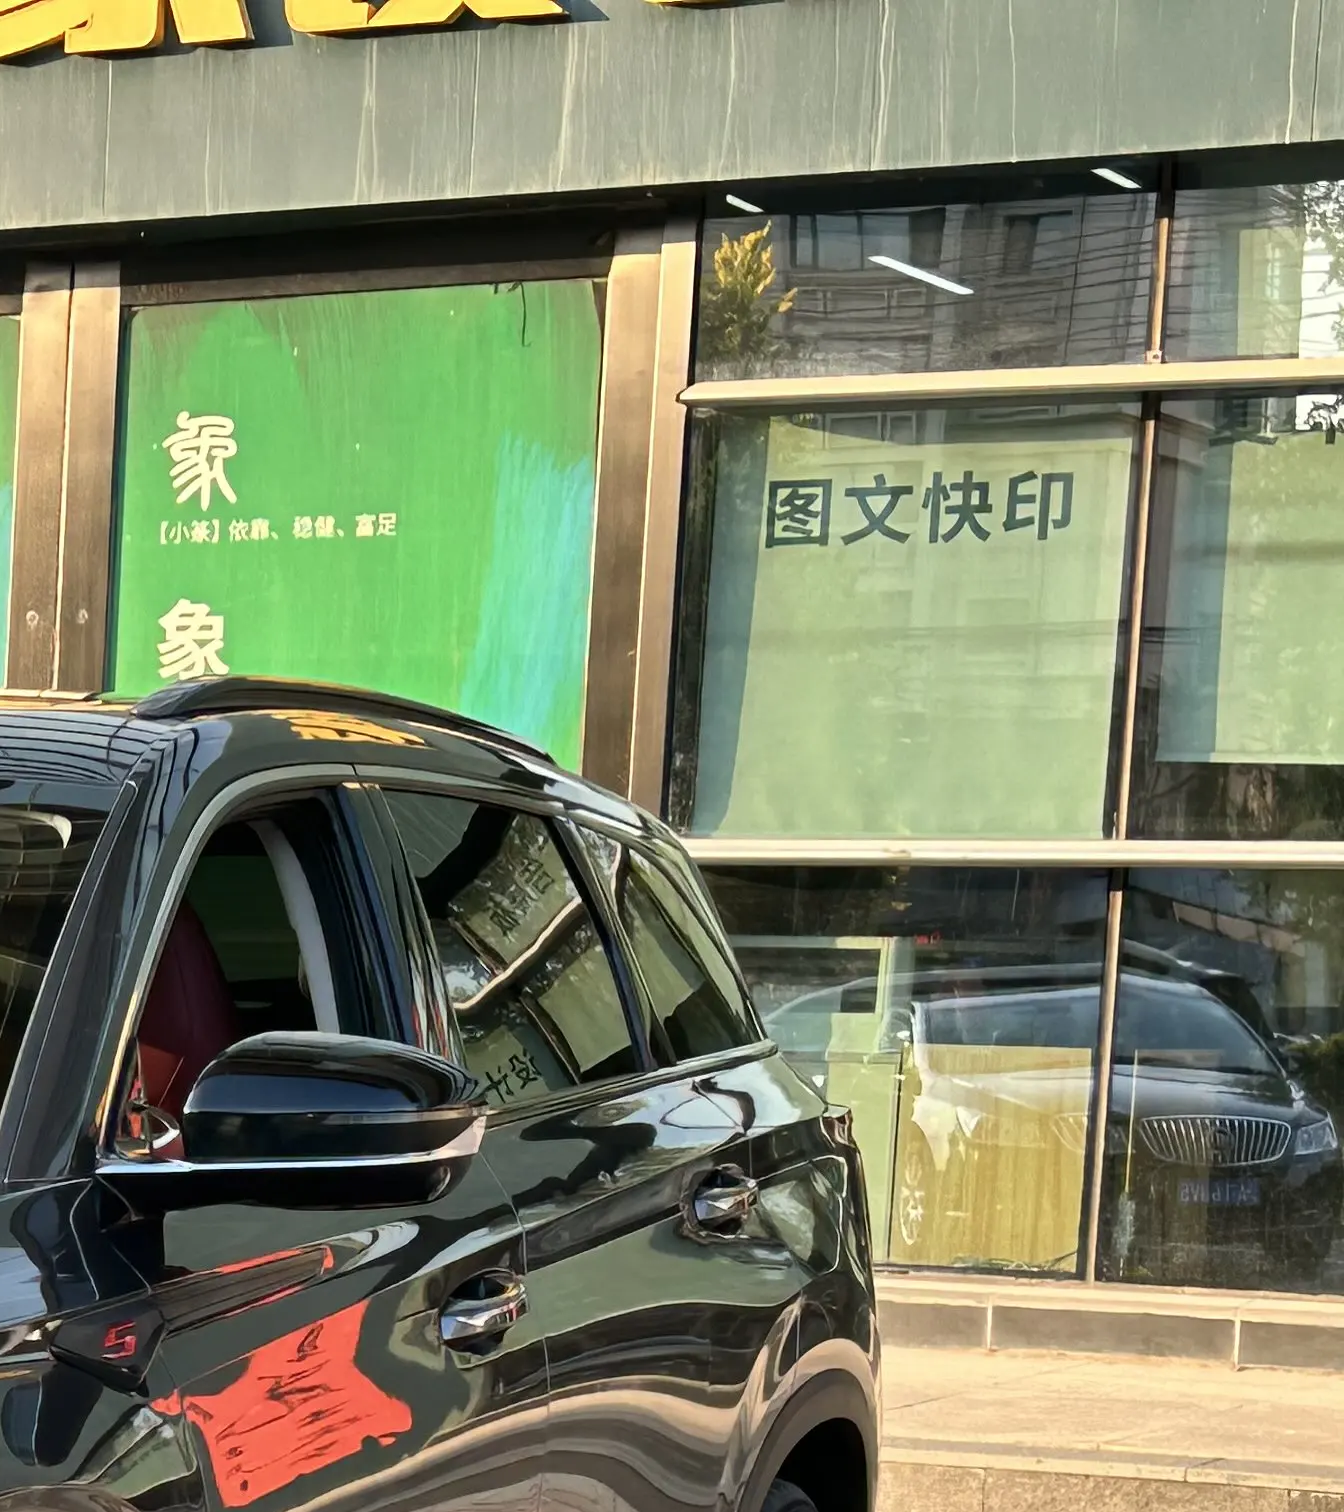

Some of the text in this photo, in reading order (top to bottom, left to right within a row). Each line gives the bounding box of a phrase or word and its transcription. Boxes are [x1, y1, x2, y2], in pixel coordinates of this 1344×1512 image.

[763, 469, 1075, 549] 图文快印
[156, 598, 230, 680] 象
